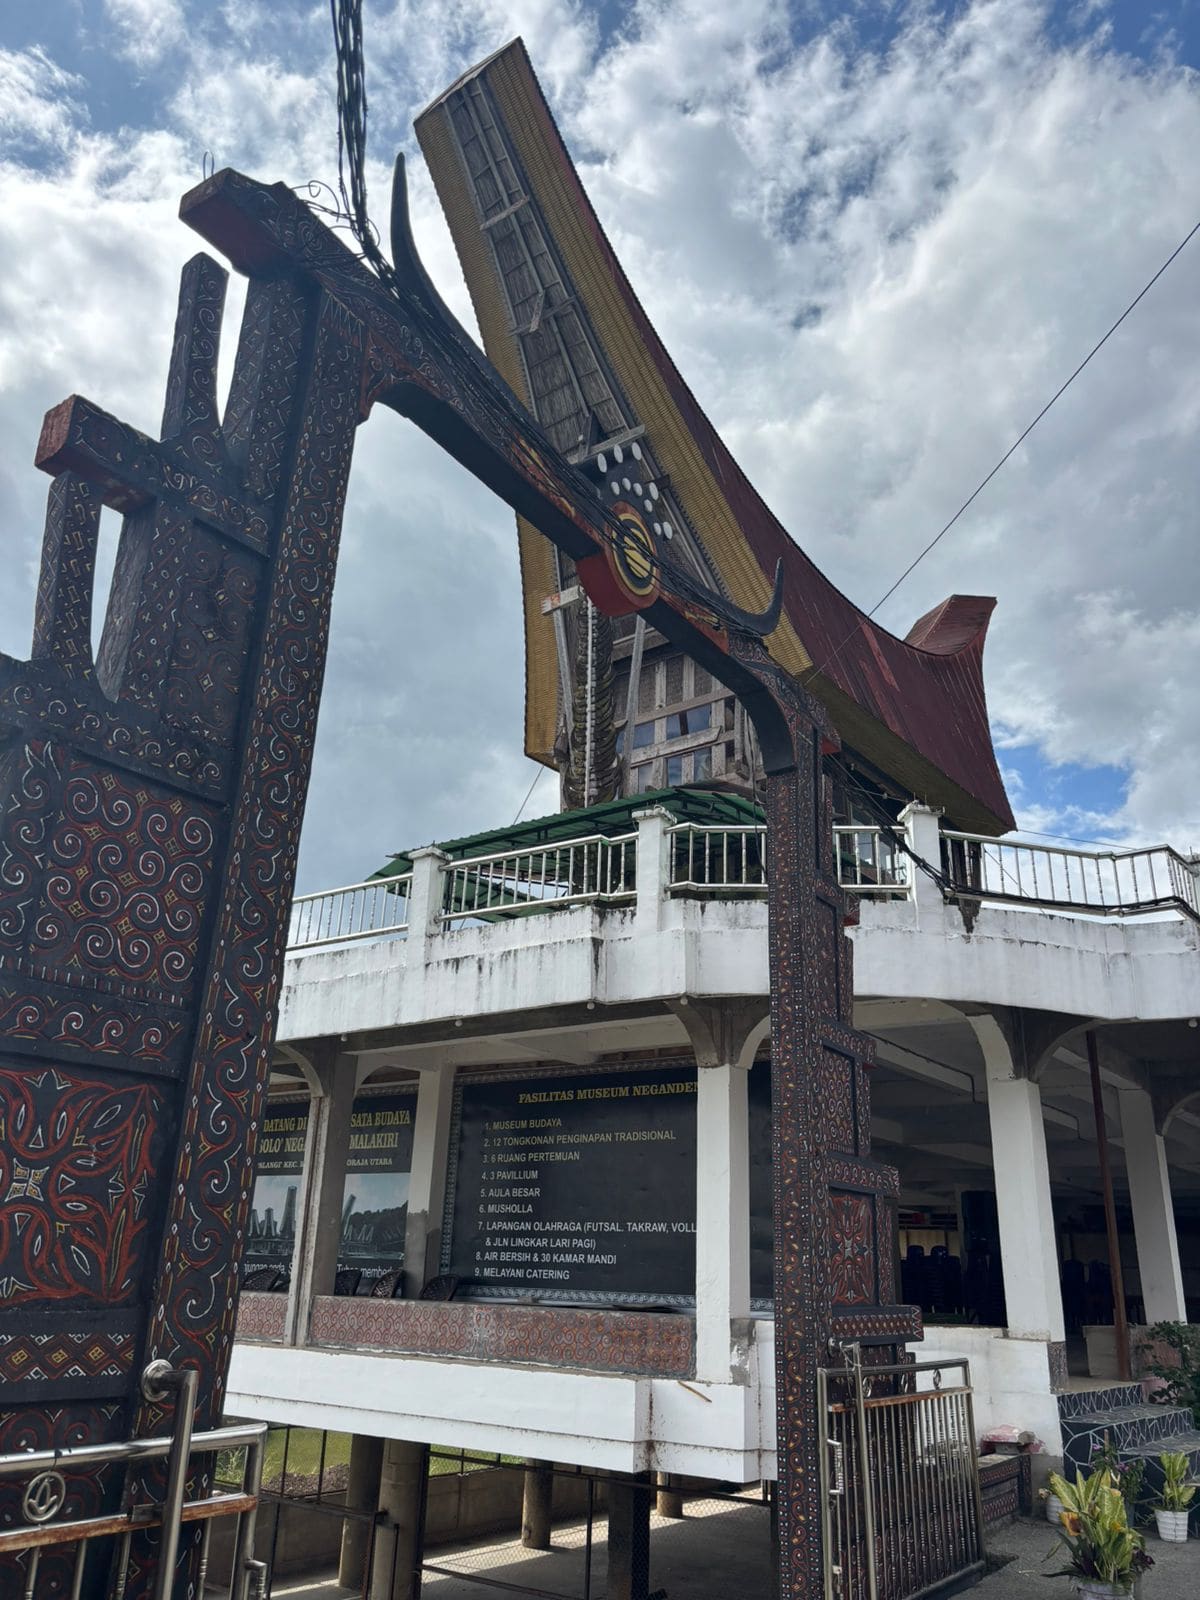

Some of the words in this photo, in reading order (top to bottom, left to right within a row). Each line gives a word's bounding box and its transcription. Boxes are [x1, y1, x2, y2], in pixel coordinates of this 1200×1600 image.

[518, 1090, 574, 1104] FASILITAS
[576, 1086, 629, 1100] MUSEUM
[263, 1118, 296, 1132] DATANG
[350, 1113, 372, 1127] SATA
[375, 1110, 411, 1126] BUDAYA
[493, 1119, 527, 1130] MUSEUM
[530, 1118, 562, 1128] BUDAYA
[284, 1137, 305, 1153] NEG
[349, 1132, 399, 1150] MALAKIRI
[493, 1138, 501, 1147] 12
[503, 1135, 554, 1146] TONGKONAN
[556, 1132, 612, 1144] PENGINAPAN
[615, 1130, 676, 1142] TRADISIONAL
[346, 1158, 369, 1166] ORAJA
[370, 1158, 392, 1166] UTARA
[497, 1152, 526, 1162] RUANG
[528, 1151, 580, 1162] PERTEMUAN
[496, 1170, 538, 1180] PAVILLIUM
[488, 1188, 510, 1197] AULA
[512, 1187, 540, 1197] BESAR
[488, 1203, 533, 1213] MUSHOLLA
[486, 1221, 531, 1231] LAPANGAN
[533, 1222, 582, 1232] OLAHRAGA
[627, 1222, 669, 1234] TAKRAW,
[671, 1222, 697, 1232] VOLL
[485, 1237, 491, 1246] &
[493, 1237, 509, 1247] JLN
[510, 1238, 548, 1248] LINGKAR
[550, 1239, 570, 1248] LARI
[572, 1239, 596, 1251] PAGI)
[484, 1251, 498, 1261] AIR
[500, 1252, 531, 1262] BERSIH
[533, 1253, 539, 1262] &
[541, 1253, 551, 1262] 30
[553, 1253, 585, 1264] KAMAR
[587, 1254, 617, 1265] MANDI
[483, 1267, 524, 1278] MELAYANI
[526, 1269, 570, 1280] CATERING
